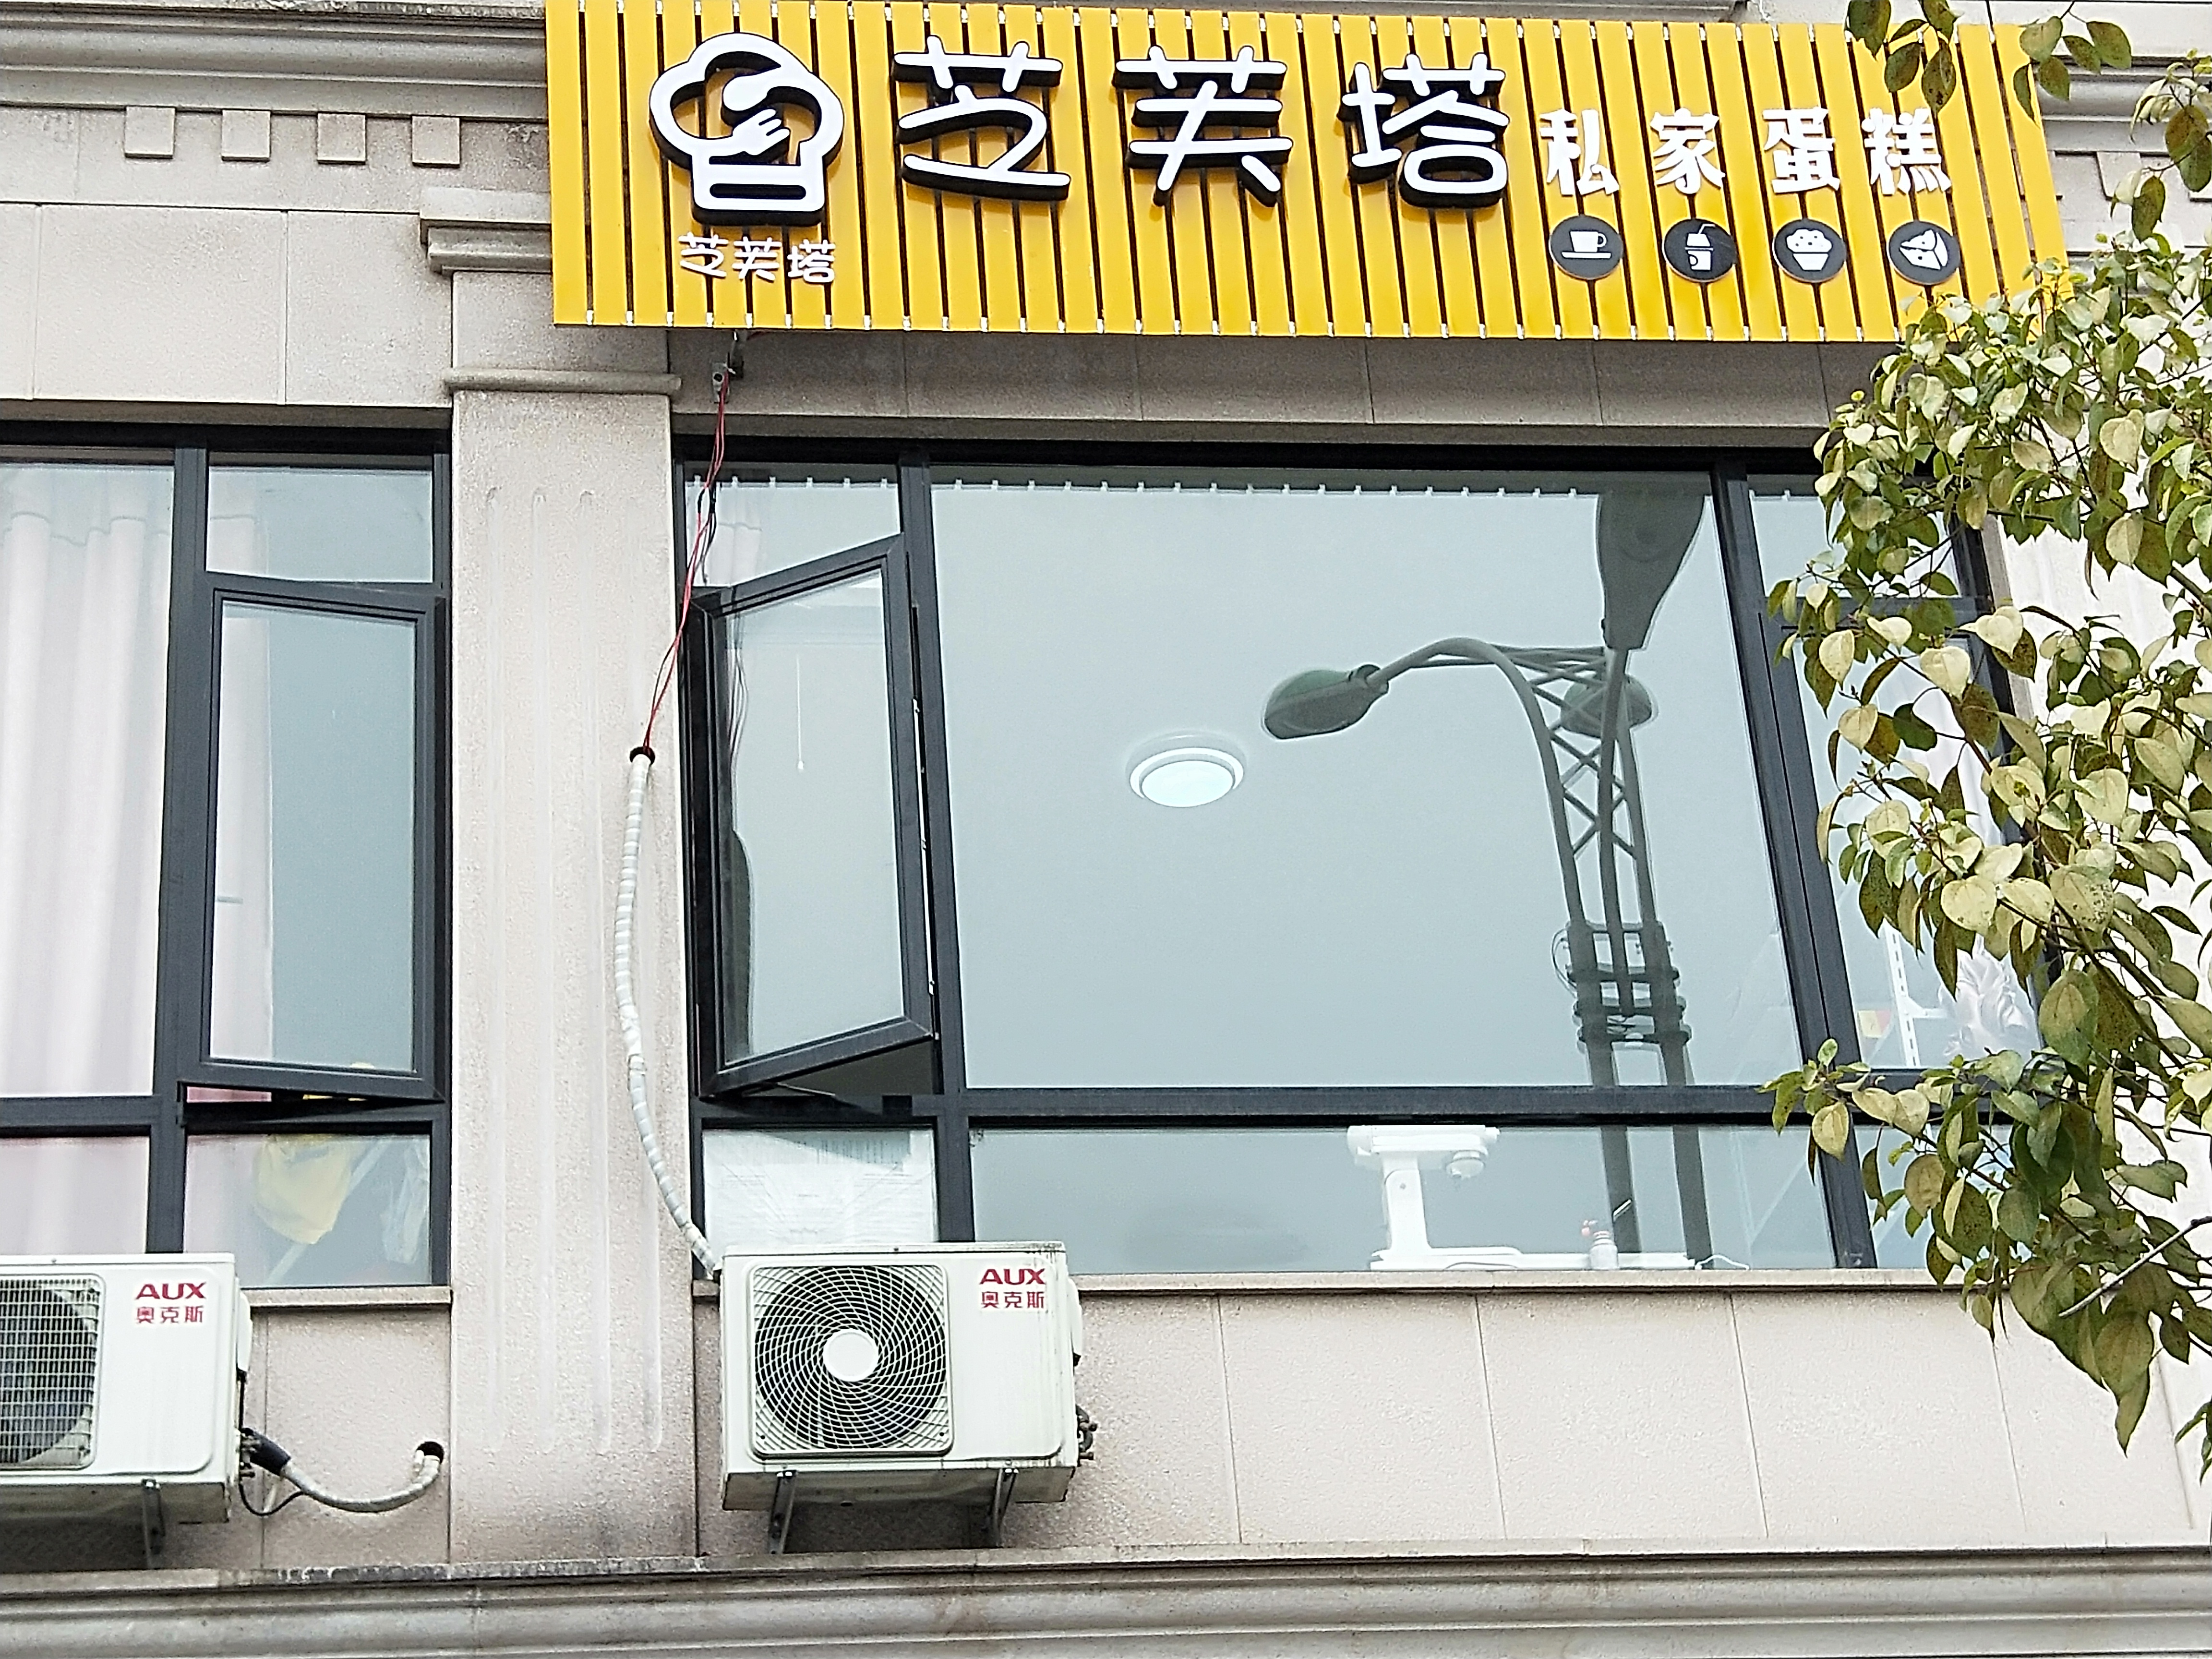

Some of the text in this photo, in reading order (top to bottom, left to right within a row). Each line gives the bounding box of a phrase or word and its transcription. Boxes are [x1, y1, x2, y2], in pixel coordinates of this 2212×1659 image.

[893, 35, 1510, 206] 芝芙塔
[1539, 107, 1953, 196] 私家蛋糕
[678, 232, 836, 283] 芝芙塔
[979, 1268, 1046, 1285] AUX
[135, 1282, 207, 1300] AUX
[981, 1291, 1045, 1309] 奥克斯
[136, 1305, 204, 1324] 奥克斯
